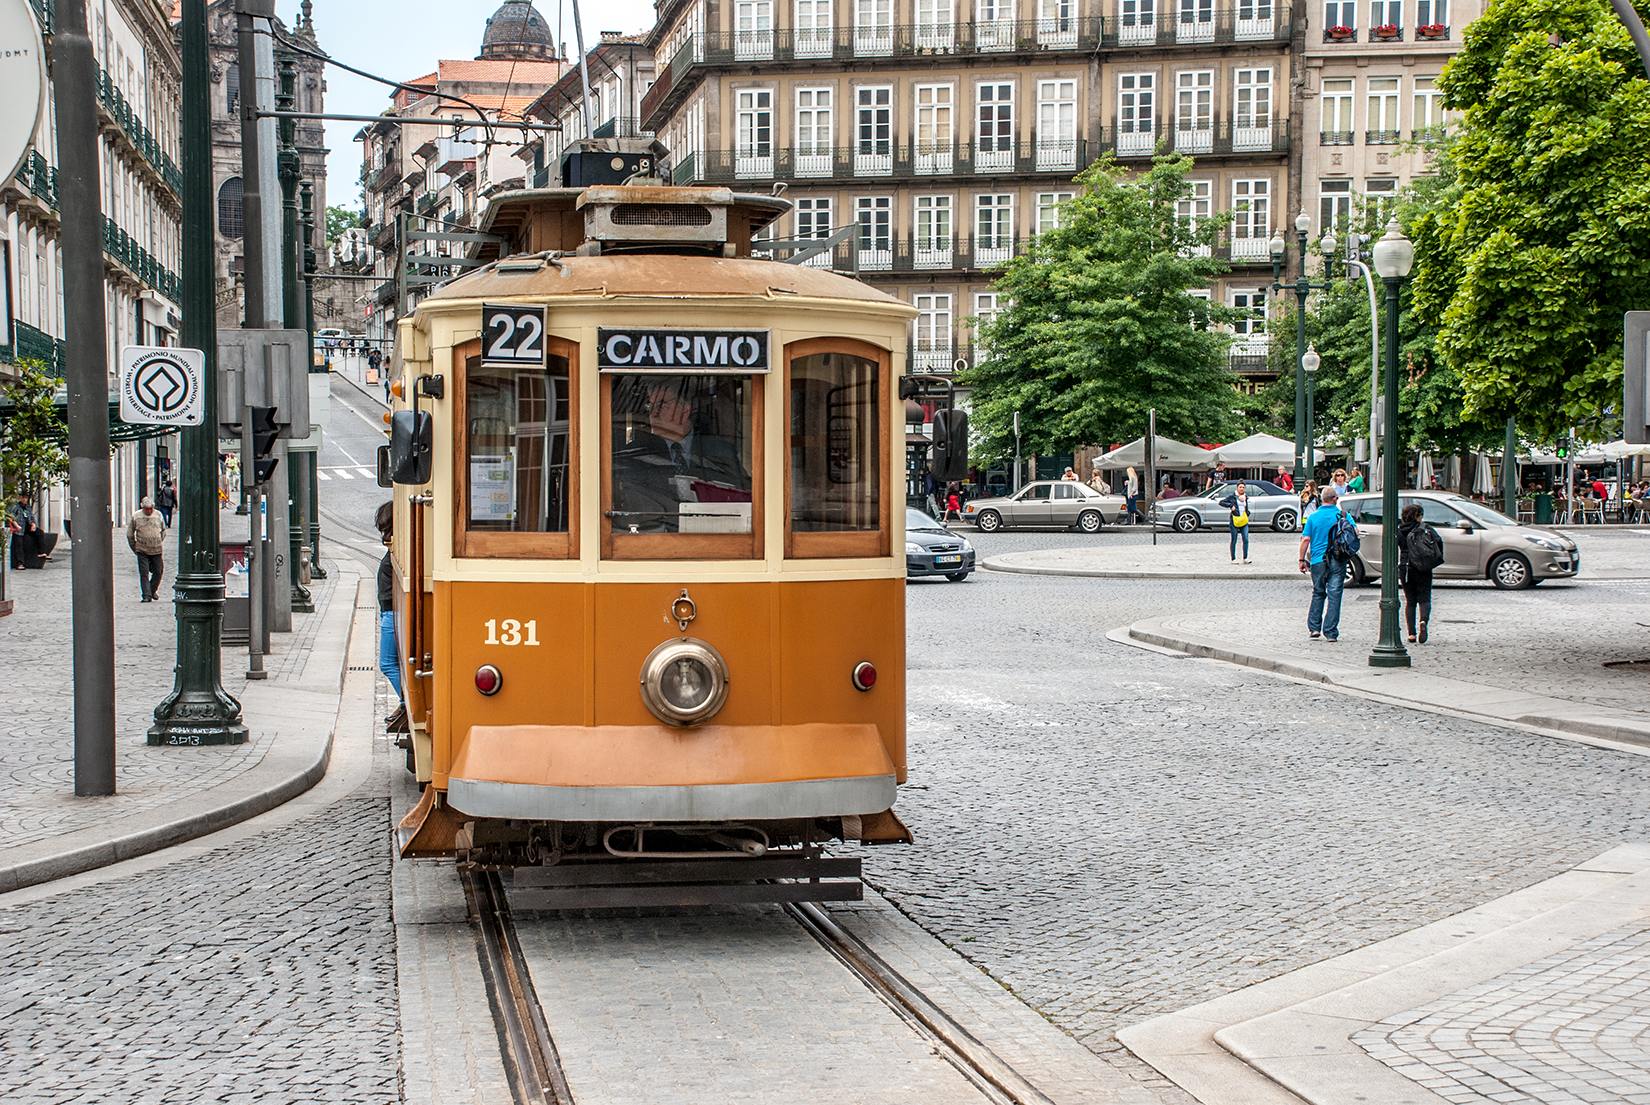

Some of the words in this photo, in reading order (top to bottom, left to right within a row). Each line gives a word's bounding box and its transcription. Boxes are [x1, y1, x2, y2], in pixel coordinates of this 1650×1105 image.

[488, 313, 542, 358] 22
[131, 351, 169, 369] PATRIMONIO
[169, 353, 194, 375] MUNDIAL
[606, 334, 760, 366] CARMO
[125, 371, 133, 395] WORLD
[127, 395, 152, 418] HERITAGE
[155, 404, 191, 421] PATRIMOINE
[188, 375, 199, 405] MONDIAL
[484, 618, 540, 646] 131
